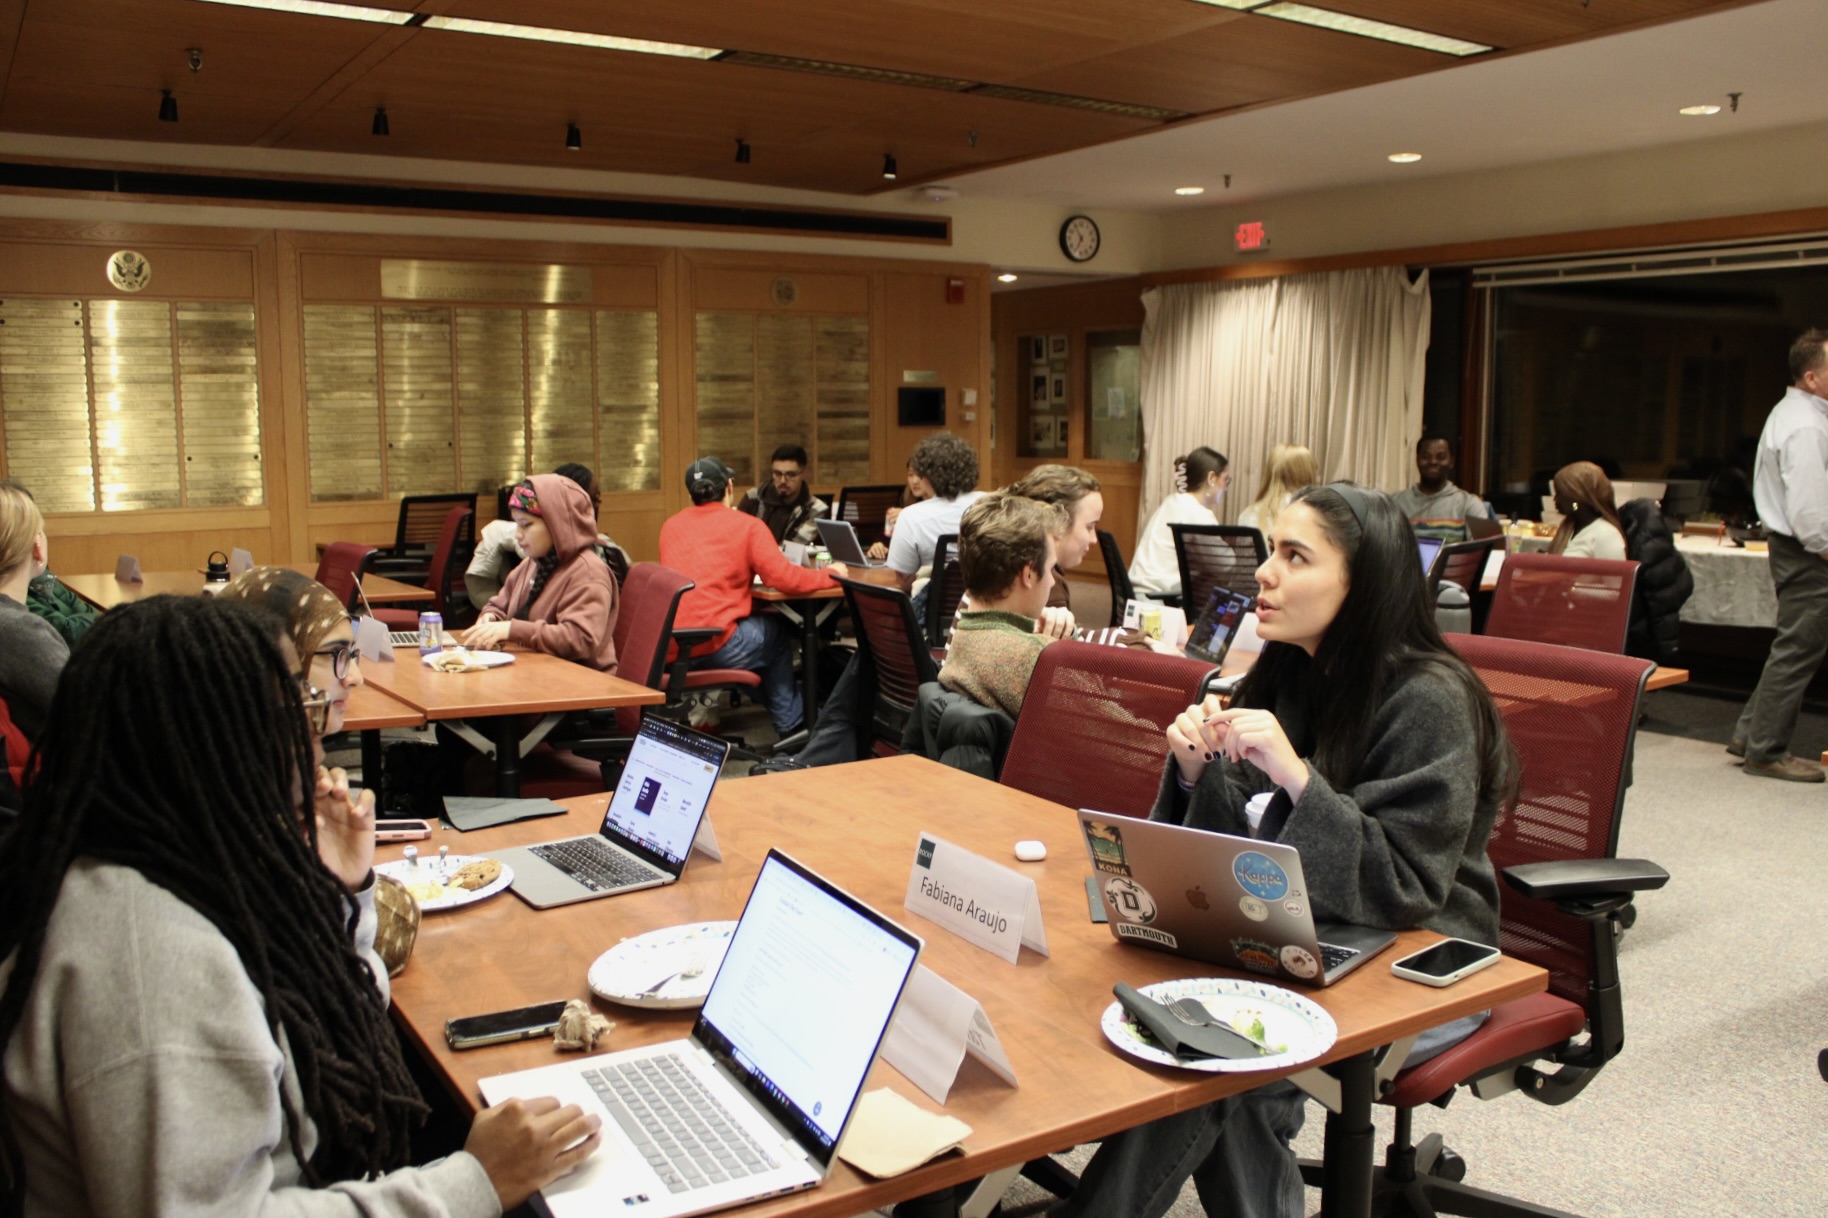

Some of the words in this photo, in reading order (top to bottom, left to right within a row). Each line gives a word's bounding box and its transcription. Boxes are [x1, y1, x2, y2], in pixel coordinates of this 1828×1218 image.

[1239, 222, 1263, 249] EXIT
[1098, 863, 1128, 876] KONA
[1238, 863, 1284, 888] Kappa
[920, 876, 964, 912] Fabiana
[965, 899, 1008, 934] Araujo
[1120, 924, 1175, 945] DARTMOUTH
